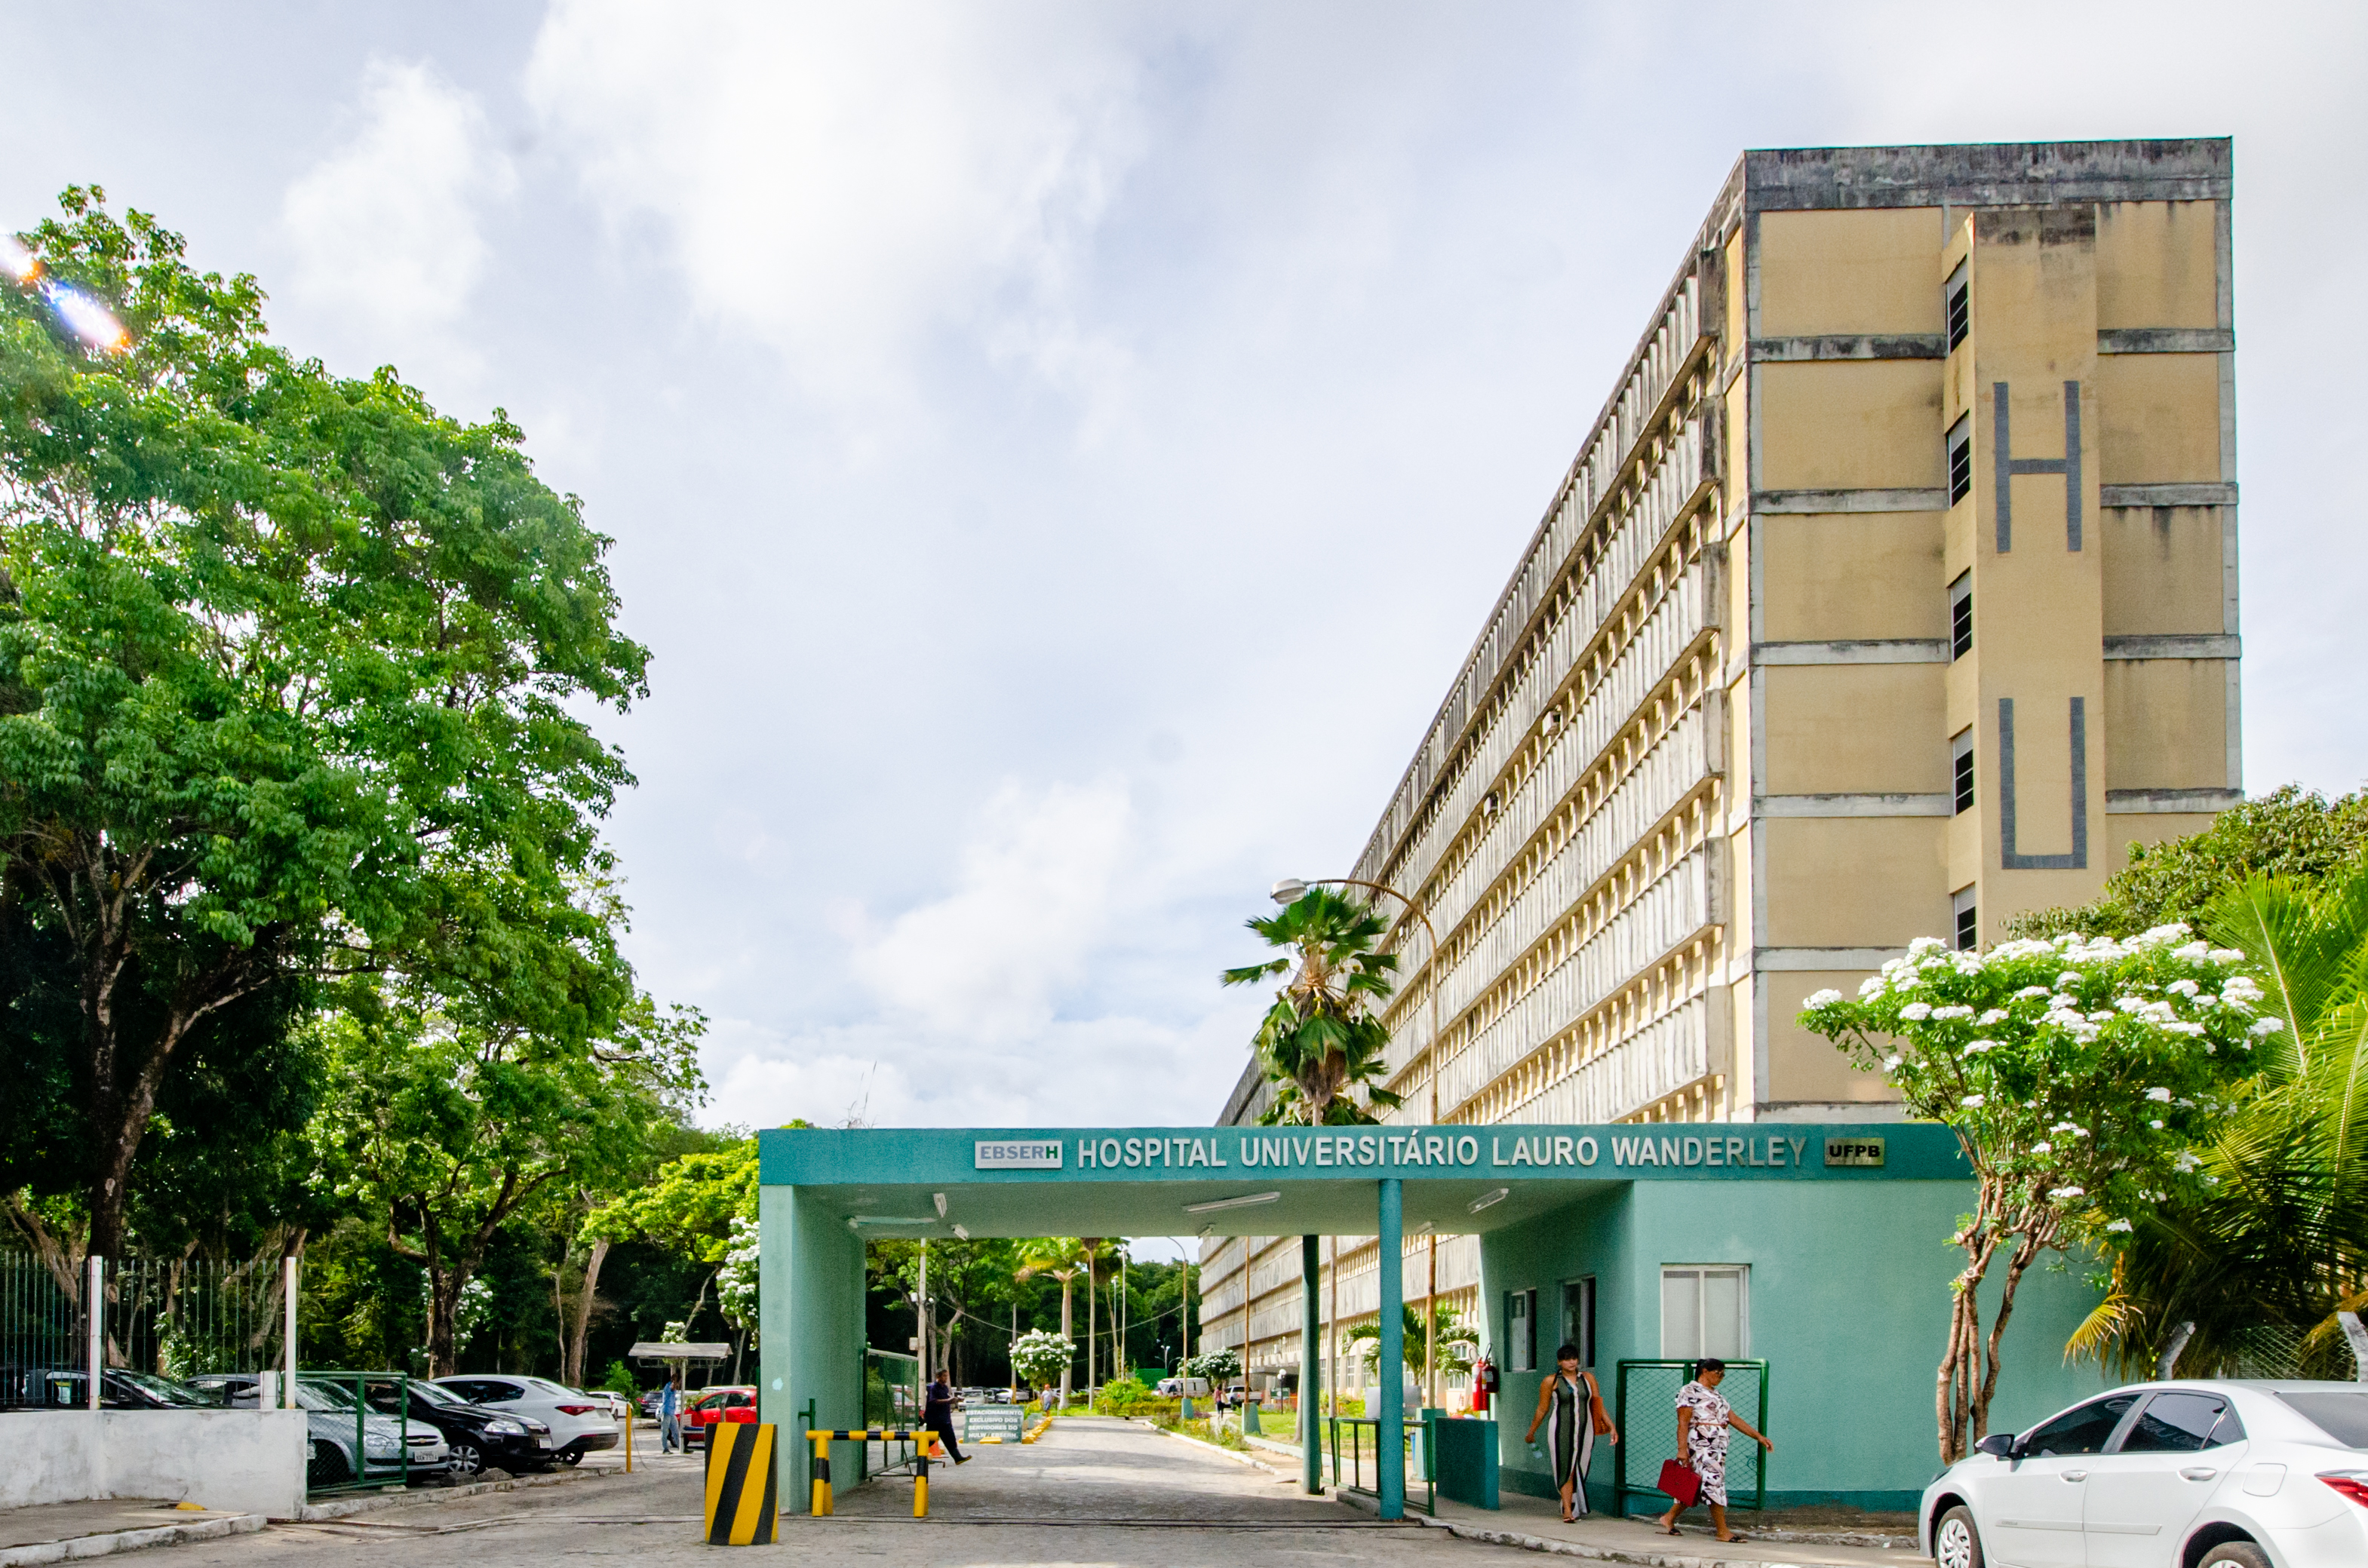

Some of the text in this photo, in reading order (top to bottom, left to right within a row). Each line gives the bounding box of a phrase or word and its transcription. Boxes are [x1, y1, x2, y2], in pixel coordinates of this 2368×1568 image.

[980, 1145, 1058, 1160] EBSERH
[1078, 1130, 1807, 1168] HOSPITAL UNIVERSITÁRIO LAURO WANDERLEY
[1829, 1144, 1880, 1158] UFPB
